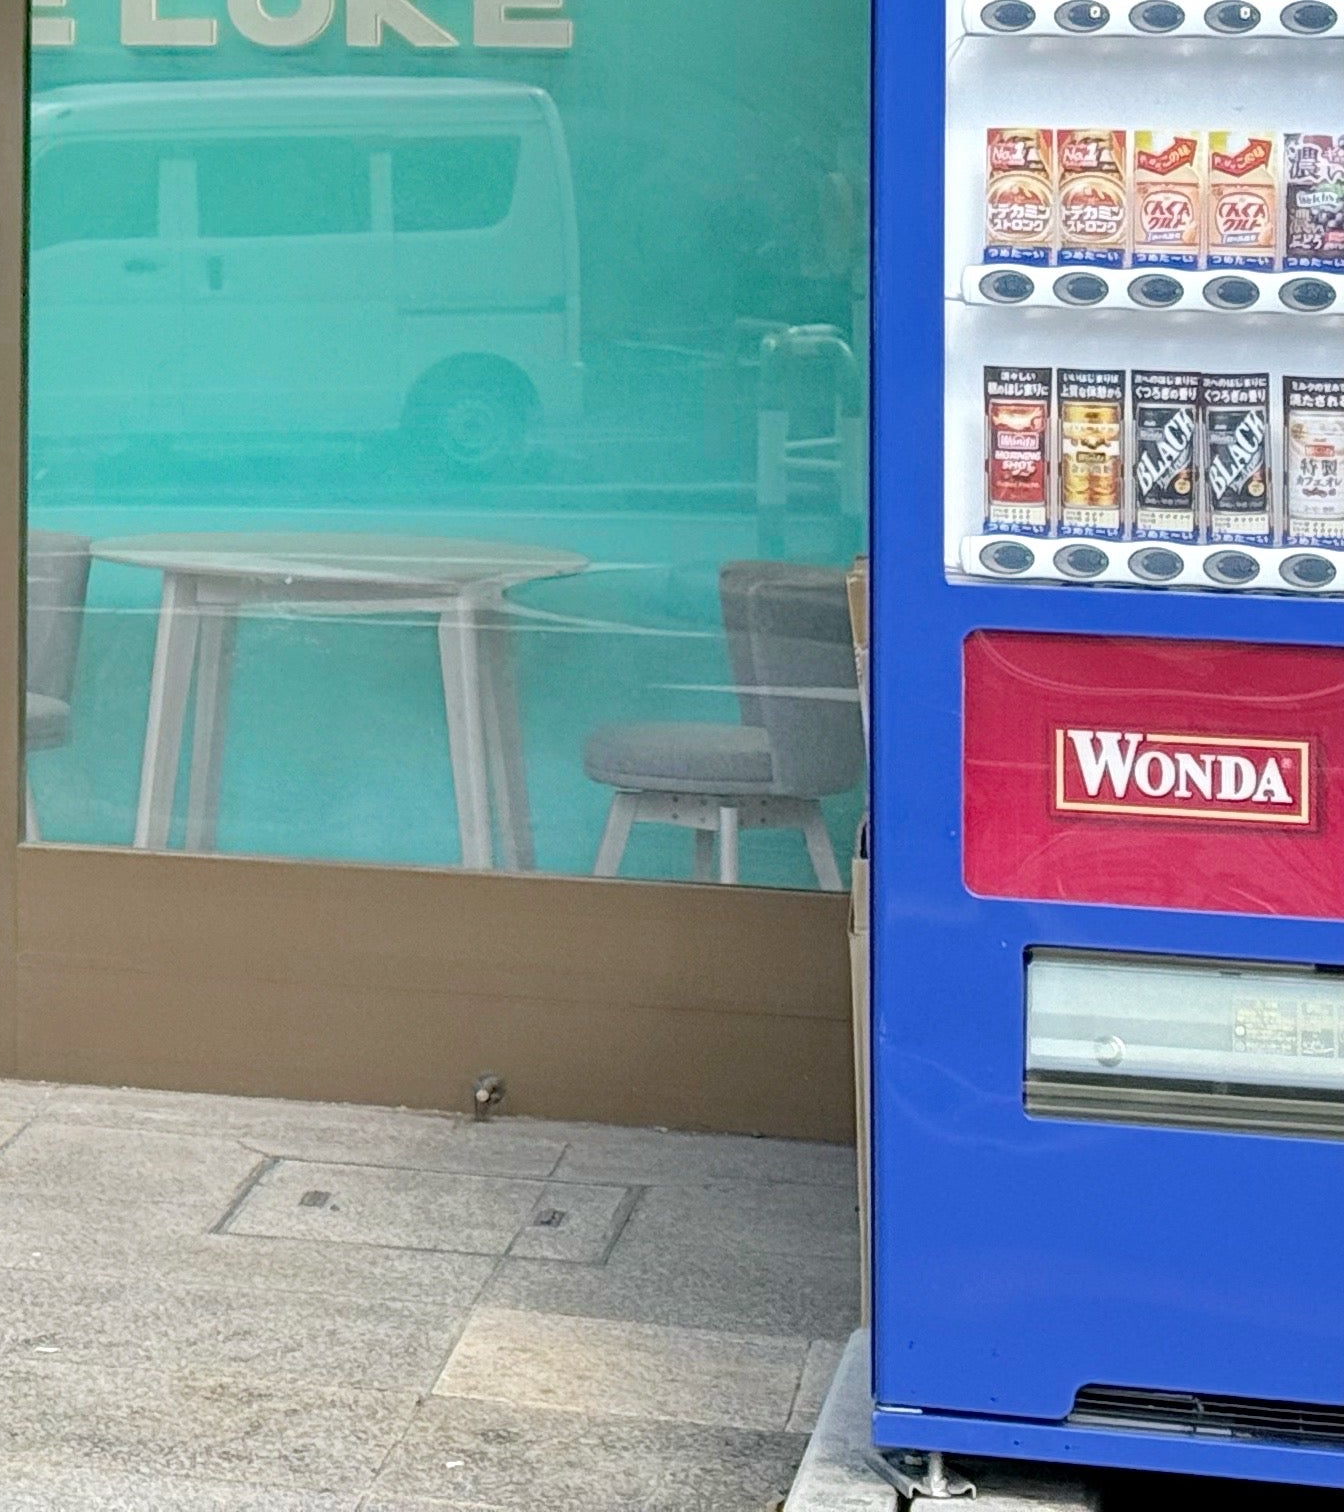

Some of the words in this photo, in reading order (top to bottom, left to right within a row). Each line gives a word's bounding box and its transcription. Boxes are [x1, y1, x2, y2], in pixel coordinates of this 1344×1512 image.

[1136, 407, 1194, 496] BLACK
[1209, 409, 1266, 500] BLACK
[1066, 728, 1294, 805] WONDA
